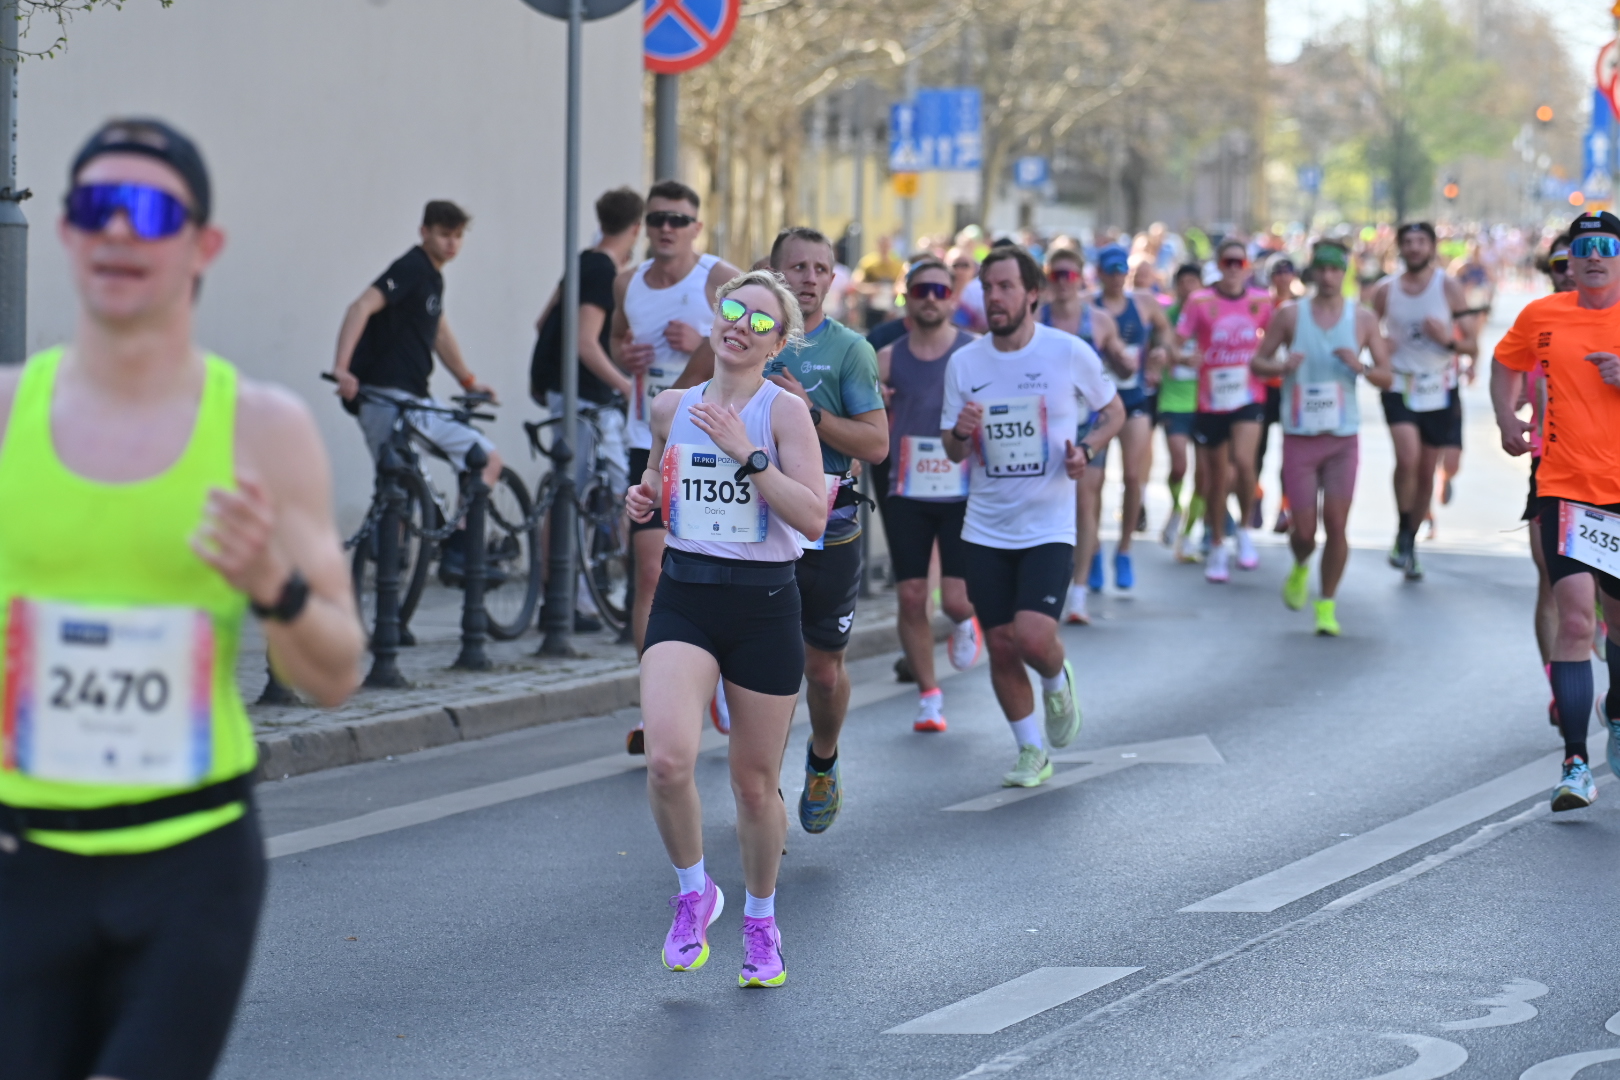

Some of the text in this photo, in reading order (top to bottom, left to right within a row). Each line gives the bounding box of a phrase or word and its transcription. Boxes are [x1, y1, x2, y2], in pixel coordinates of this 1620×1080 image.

[985, 421, 1034, 440] 13316
[693, 456, 715, 464] 17.PKO
[916, 459, 952, 473] 6125
[682, 478, 751, 504] 11303
[704, 506, 726, 515] Daria
[1579, 524, 1620, 552] 2635
[49, 665, 169, 714] 2470
